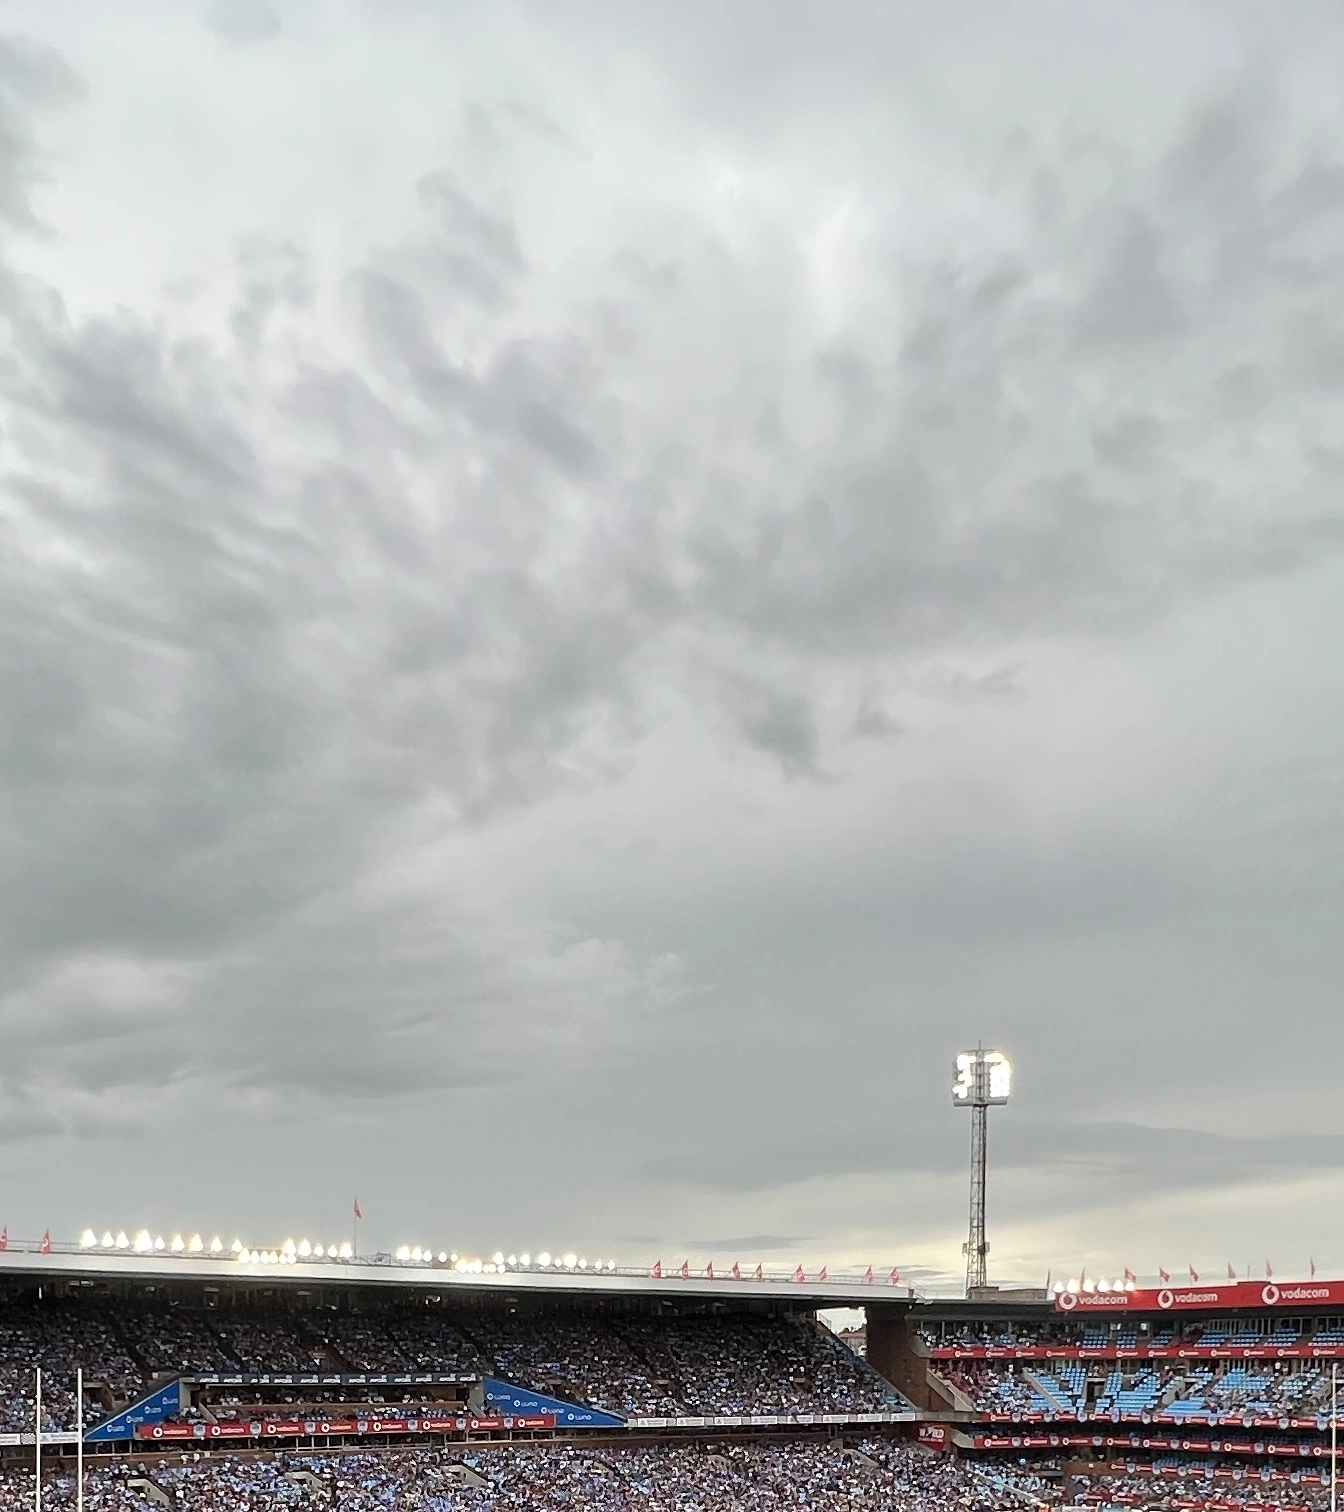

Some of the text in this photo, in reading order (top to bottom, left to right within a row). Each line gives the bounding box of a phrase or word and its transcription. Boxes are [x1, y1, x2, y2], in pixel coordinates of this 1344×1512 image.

[1079, 1294, 1128, 1306] vodacom
[1175, 1291, 1218, 1304] vodacom
[1281, 1287, 1329, 1300] vodacom
